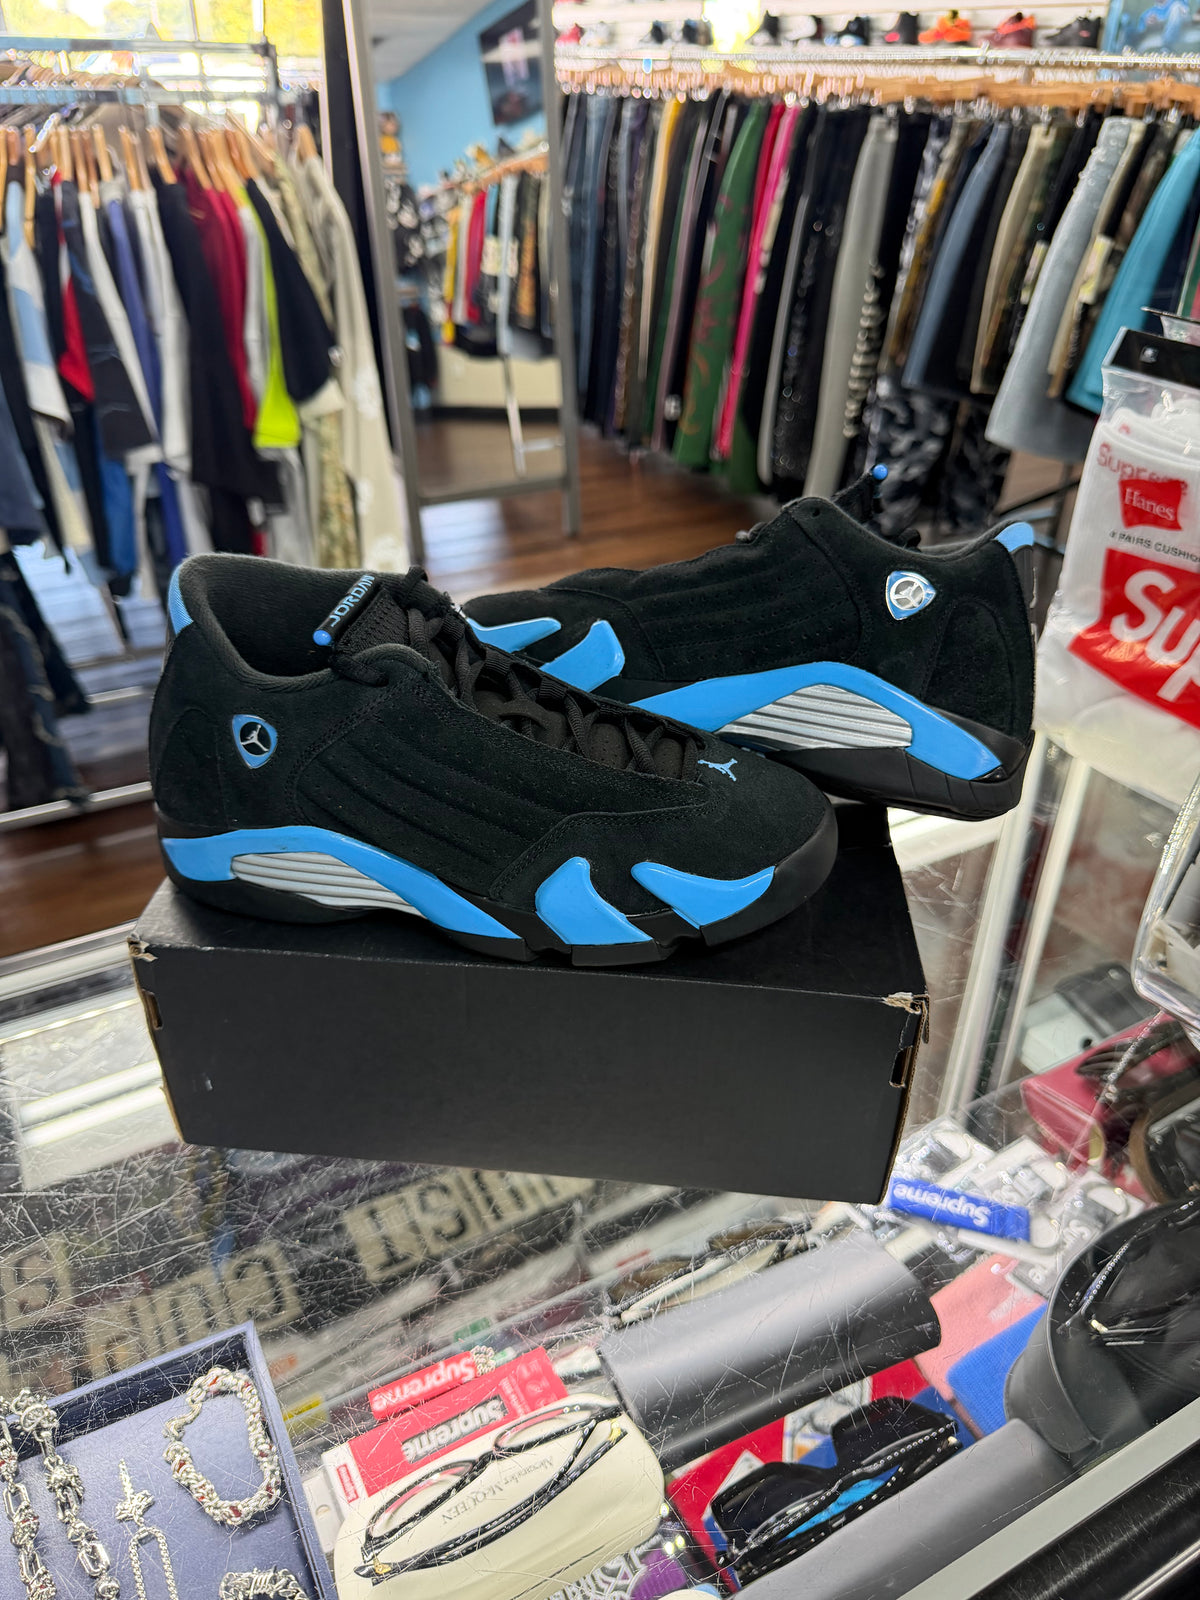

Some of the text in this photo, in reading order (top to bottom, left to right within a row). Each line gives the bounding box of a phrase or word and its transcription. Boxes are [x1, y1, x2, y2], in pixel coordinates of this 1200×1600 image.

[1124, 487, 1176, 521] Hanes
[1118, 533, 1152, 549] PAIRS
[1154, 542, 1200, 563] CUSHIO
[329, 574, 375, 628] JORDAN
[892, 1182, 992, 1228] Supreme
[371, 1356, 476, 1412] Supreme
[401, 1398, 504, 1458] Supreme
[442, 1455, 553, 1525] Alexander McQUEEN
